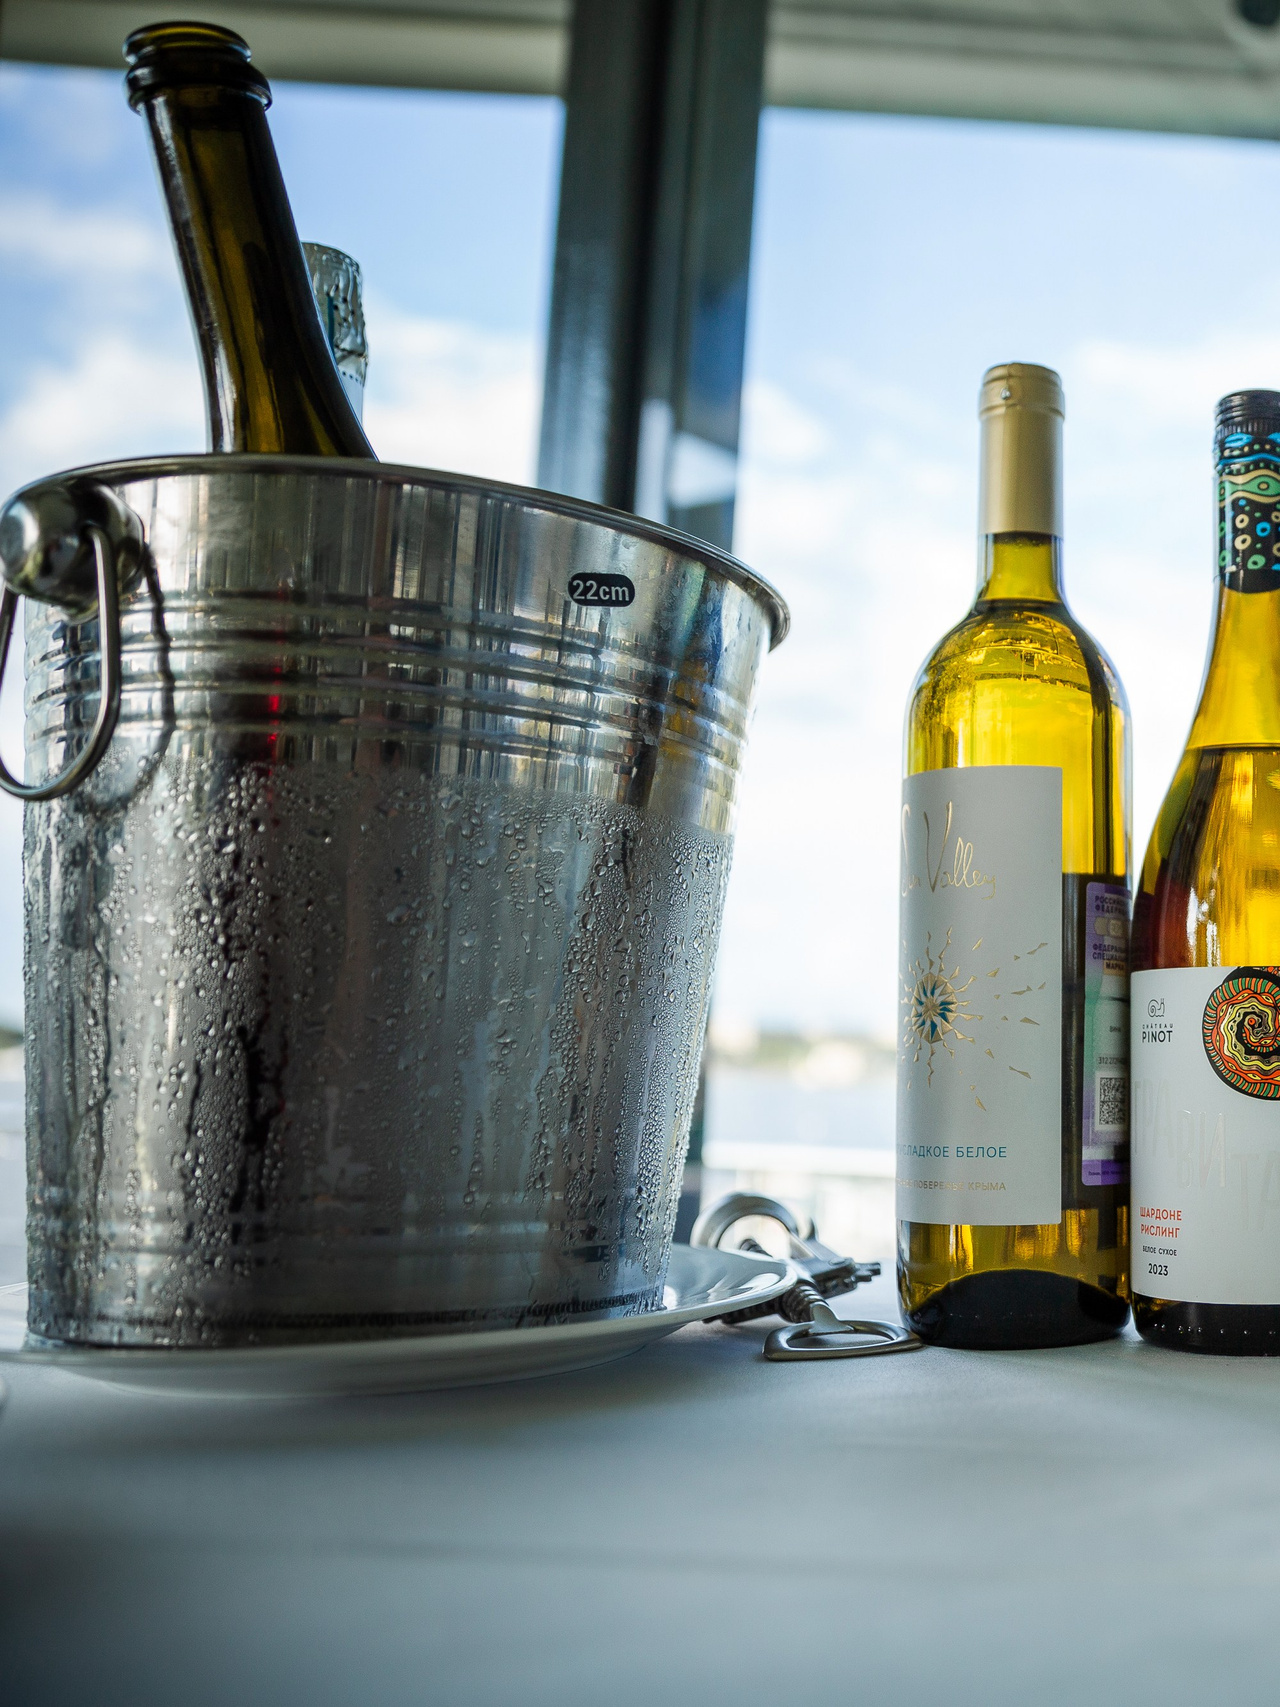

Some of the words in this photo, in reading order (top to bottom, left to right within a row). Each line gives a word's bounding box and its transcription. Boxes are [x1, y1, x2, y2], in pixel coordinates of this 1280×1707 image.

[572, 579, 630, 601] 22cm
[923, 800, 996, 900] Valley
[1142, 1030, 1173, 1043] PINOT
[898, 1145, 949, 1158] СЛАДКОЕ
[956, 1146, 1007, 1158] БЕЛОЕ
[968, 1182, 1007, 1191] КРЫМА
[1140, 1207, 1182, 1221] ШАРДОНЕ
[1141, 1224, 1180, 1238] РИСЛИНГ
[1142, 1245, 1157, 1254] БЕЛОЕ
[1158, 1248, 1177, 1257] СУХОЕ
[1148, 1263, 1169, 1277] 2023
